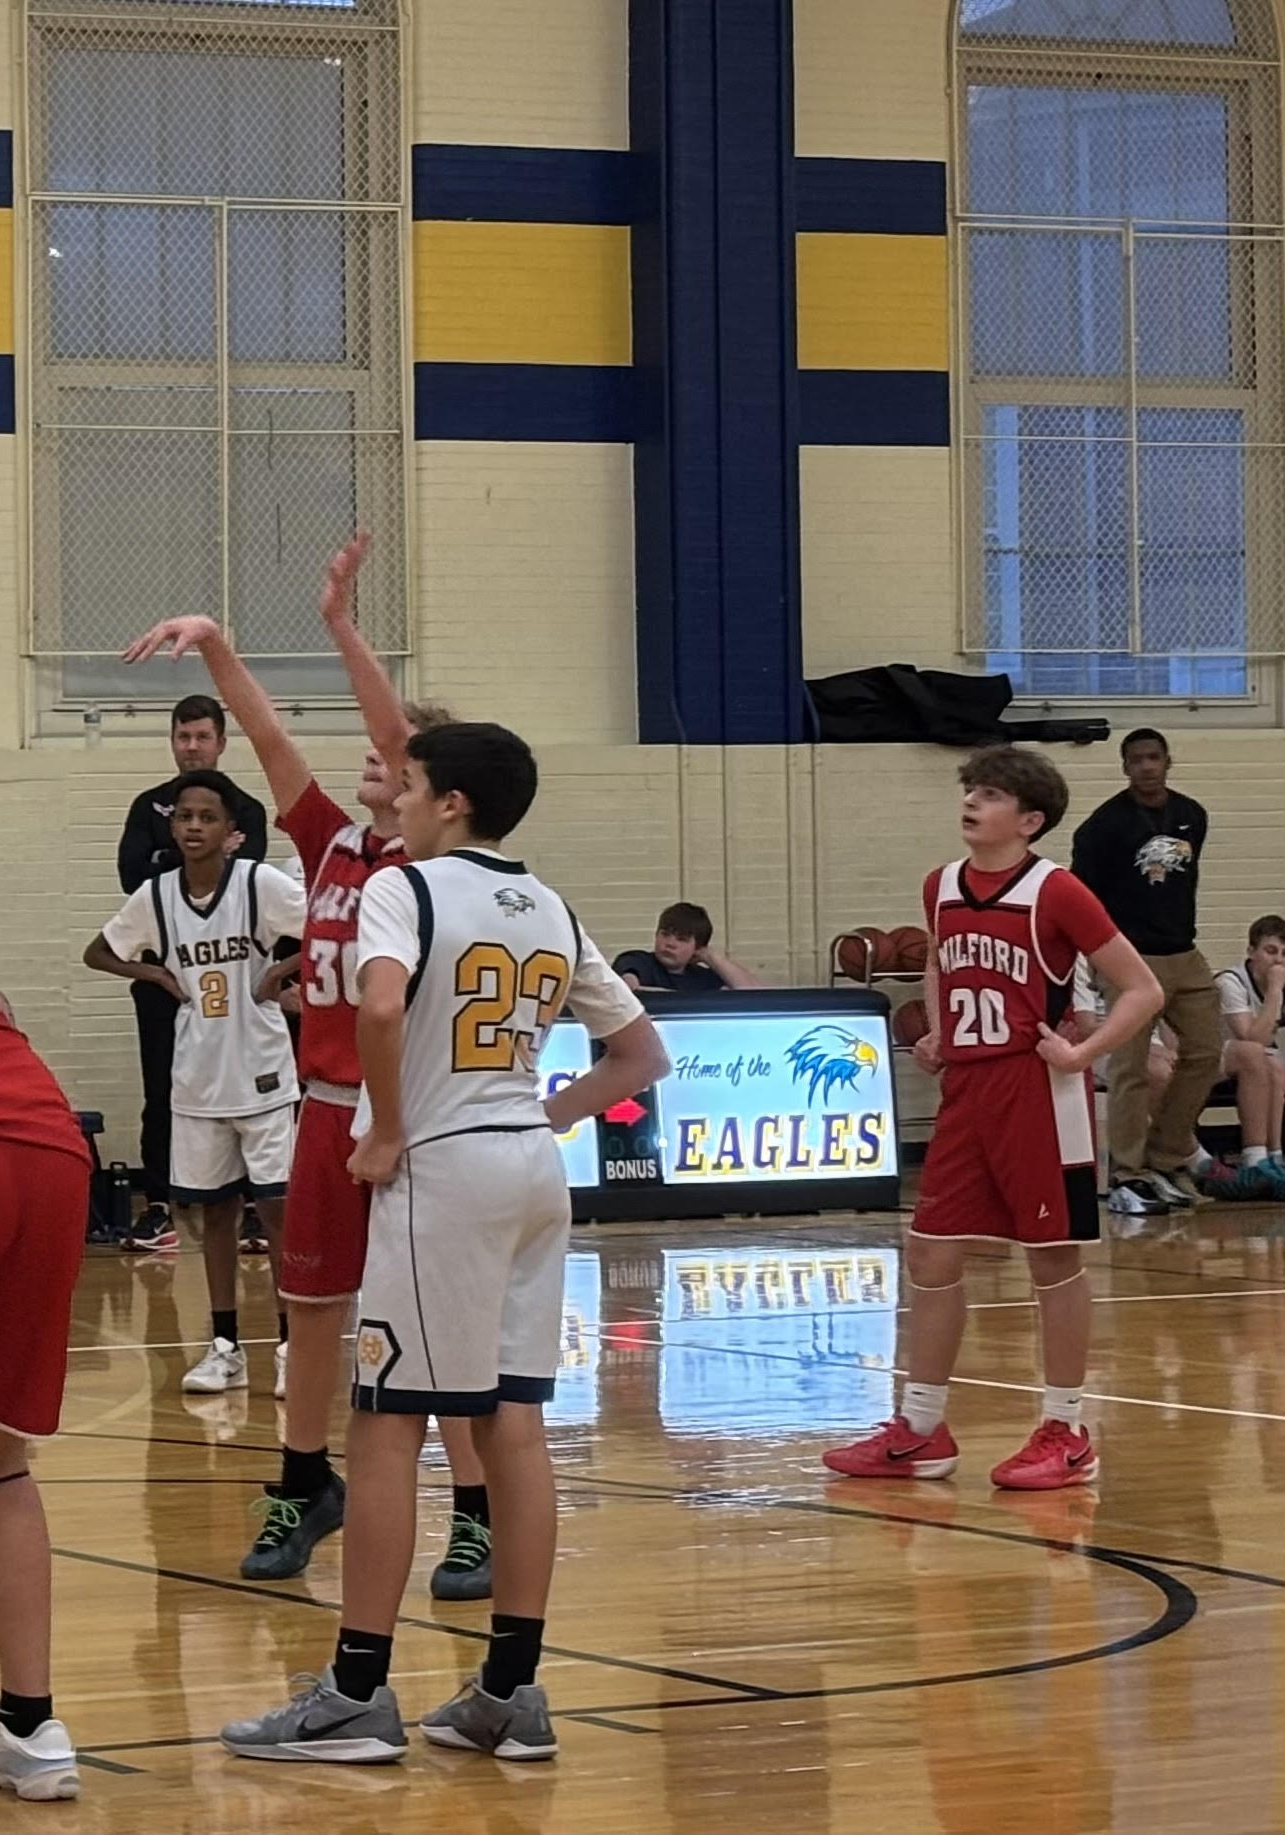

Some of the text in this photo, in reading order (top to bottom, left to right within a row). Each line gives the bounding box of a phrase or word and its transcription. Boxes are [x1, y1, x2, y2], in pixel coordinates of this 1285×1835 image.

[175, 935, 251, 969] AGLES
[199, 970, 230, 1019] 2
[451, 942, 570, 1074] 23
[949, 987, 1011, 1047] 20
[674, 1054, 773, 1087] Home of the
[673, 1110, 887, 1177] EAGLES
[605, 1159, 657, 1180] BONUS
